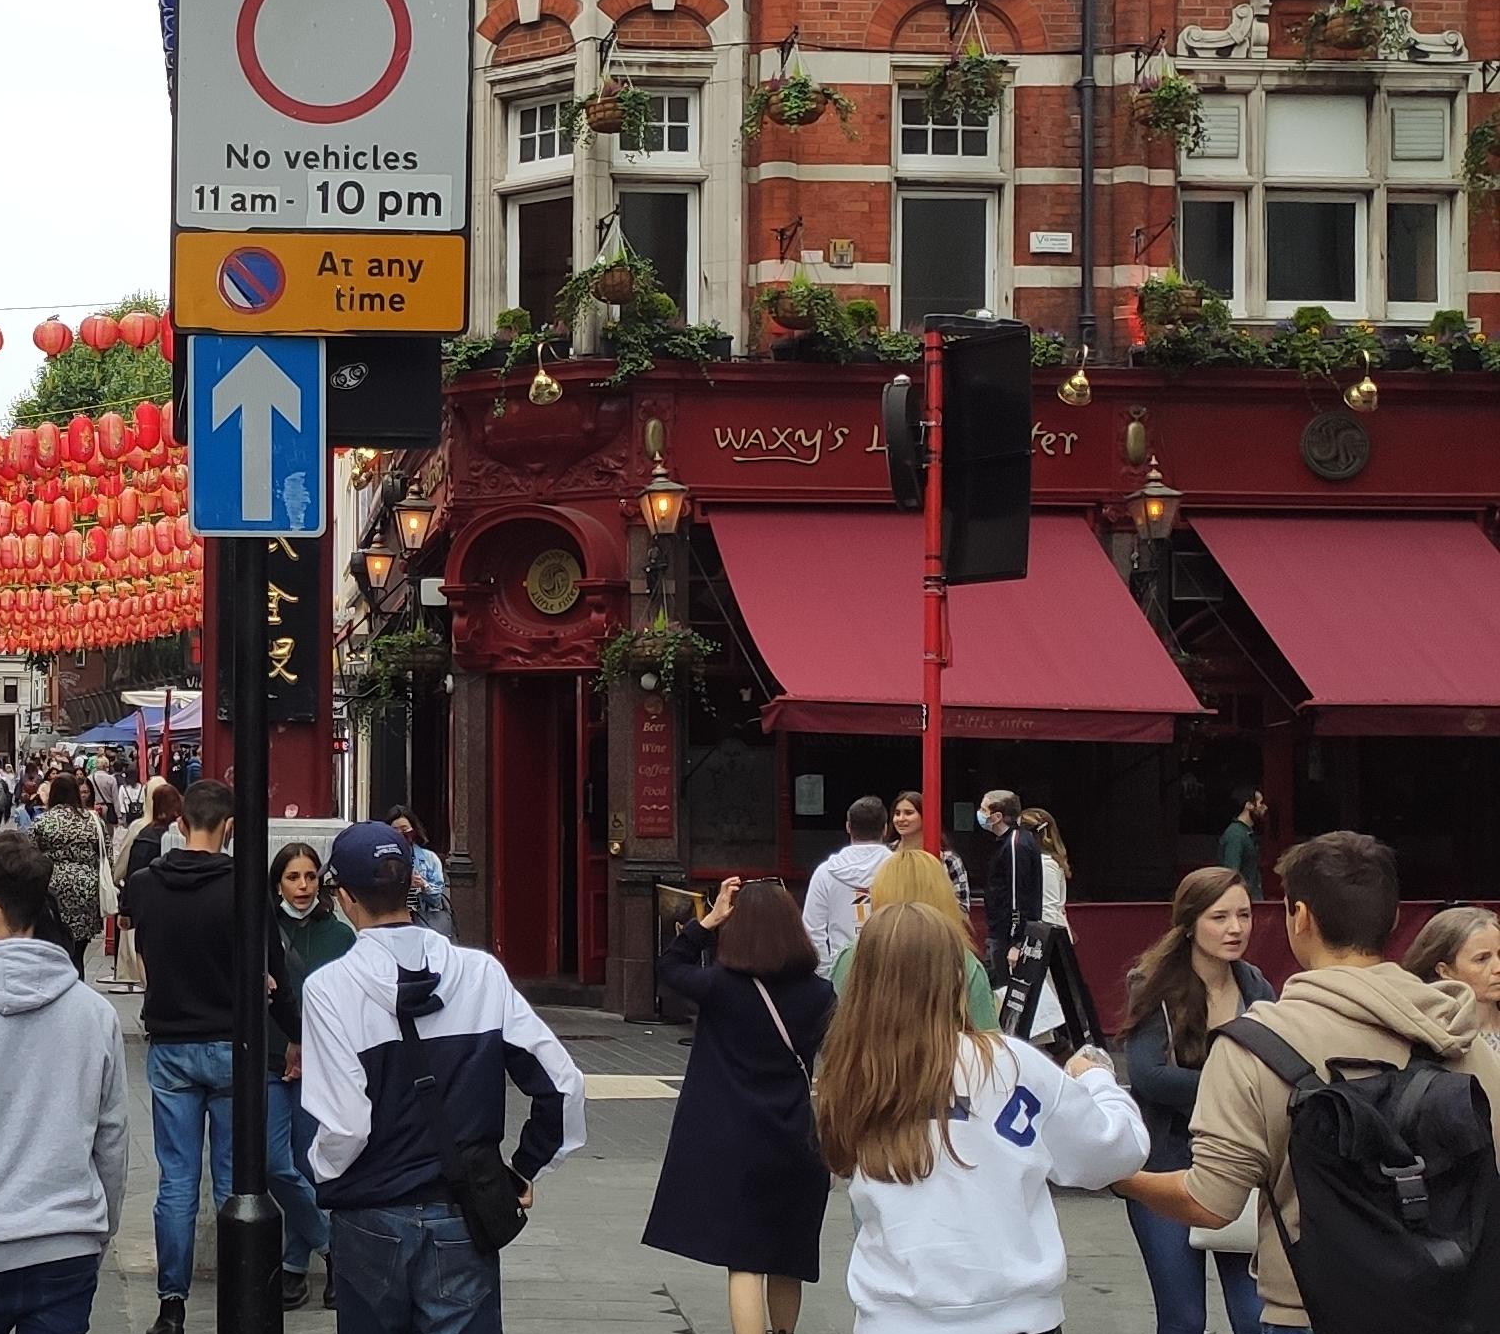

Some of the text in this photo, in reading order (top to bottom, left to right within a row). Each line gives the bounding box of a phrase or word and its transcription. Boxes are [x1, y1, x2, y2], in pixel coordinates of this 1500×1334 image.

[225, 142, 419, 172] No vehicles
[315, 180, 365, 216] 10
[377, 185, 444, 223] pm
[317, 251, 425, 285] At any
[334, 285, 407, 313] time
[642, 722, 667, 732] Beer
[641, 743, 667, 754] Wine
[638, 764, 671, 778] Coffee
[642, 786, 668, 796] Food
